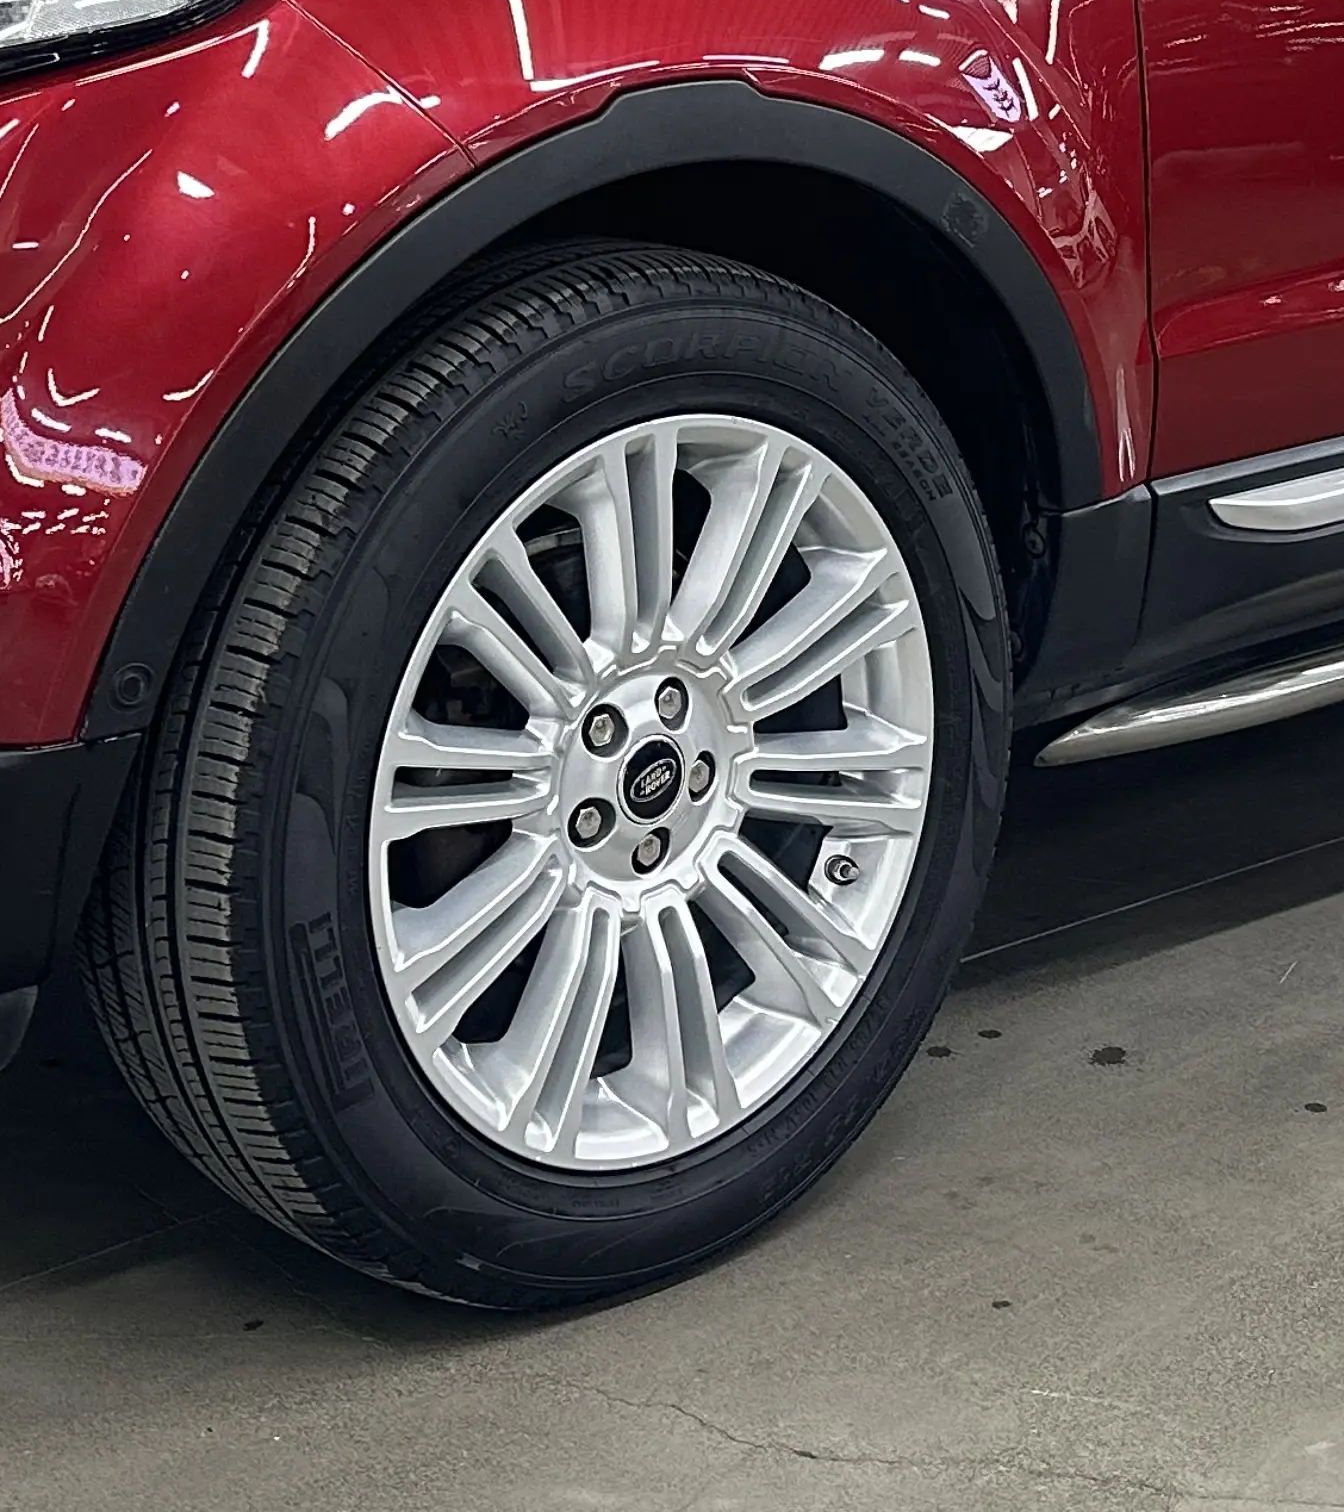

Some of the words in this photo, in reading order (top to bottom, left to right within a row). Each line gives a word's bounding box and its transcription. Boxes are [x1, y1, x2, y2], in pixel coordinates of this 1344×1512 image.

[560, 329, 854, 404] SCORPION
[641, 767, 662, 788] LAND
[645, 770, 670, 796] ROVER
